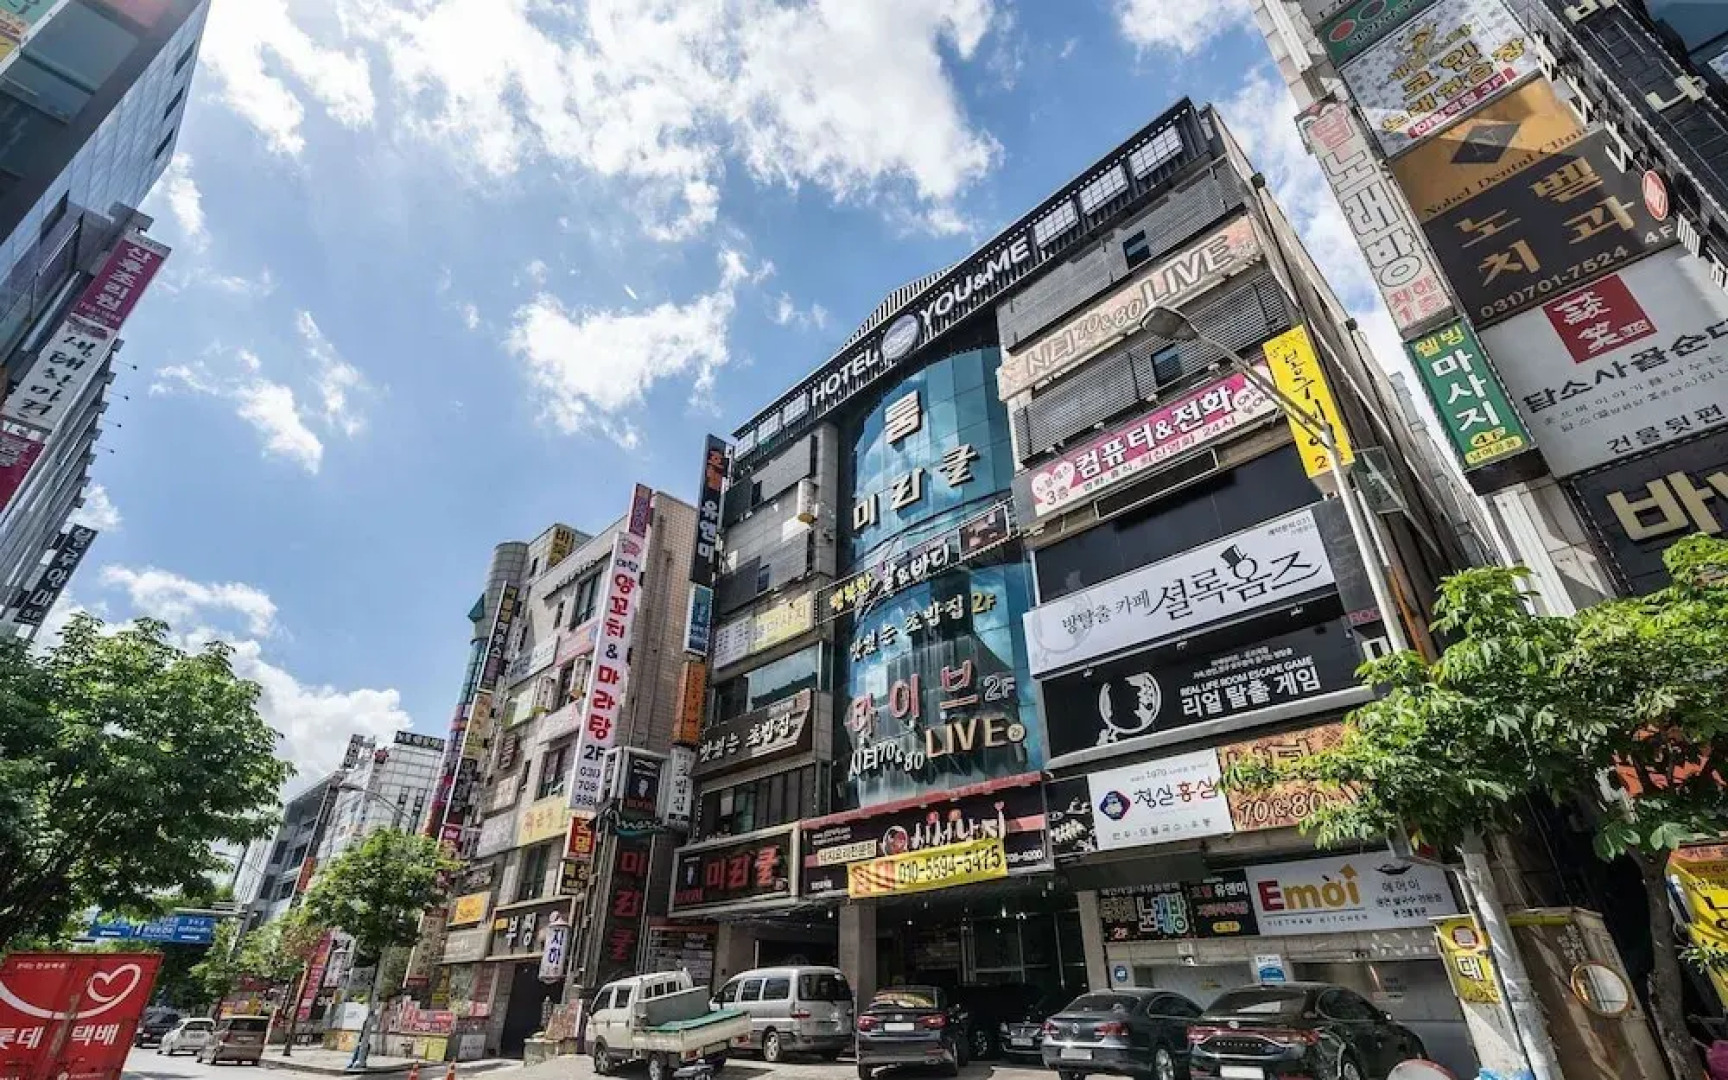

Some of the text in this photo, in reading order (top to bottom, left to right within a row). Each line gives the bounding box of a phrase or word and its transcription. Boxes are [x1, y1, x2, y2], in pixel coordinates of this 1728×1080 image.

[1424, 187, 1471, 215] Nobel
[1478, 151, 1538, 191] Dental
[1141, 234, 1234, 307] LIVE
[1480, 245, 1629, 319] 031)701-7524
[811, 236, 1029, 407] HOTEL YOU&ME
[1415, 325, 1465, 357] 웰빙
[1431, 348, 1500, 432] 마사지
[1075, 385, 1234, 480] 컴퓨터&전화
[972, 592, 997, 614] 2F
[1115, 589, 1150, 616] 카페
[983, 675, 1016, 702] 2F
[1284, 655, 1314, 671] GAME
[588, 665, 620, 740] 마라탕
[1182, 689, 1223, 717] 리얼
[1273, 665, 1321, 696] 게임
[925, 715, 1005, 759] LIVE
[71, 1023, 120, 1047] 택배
